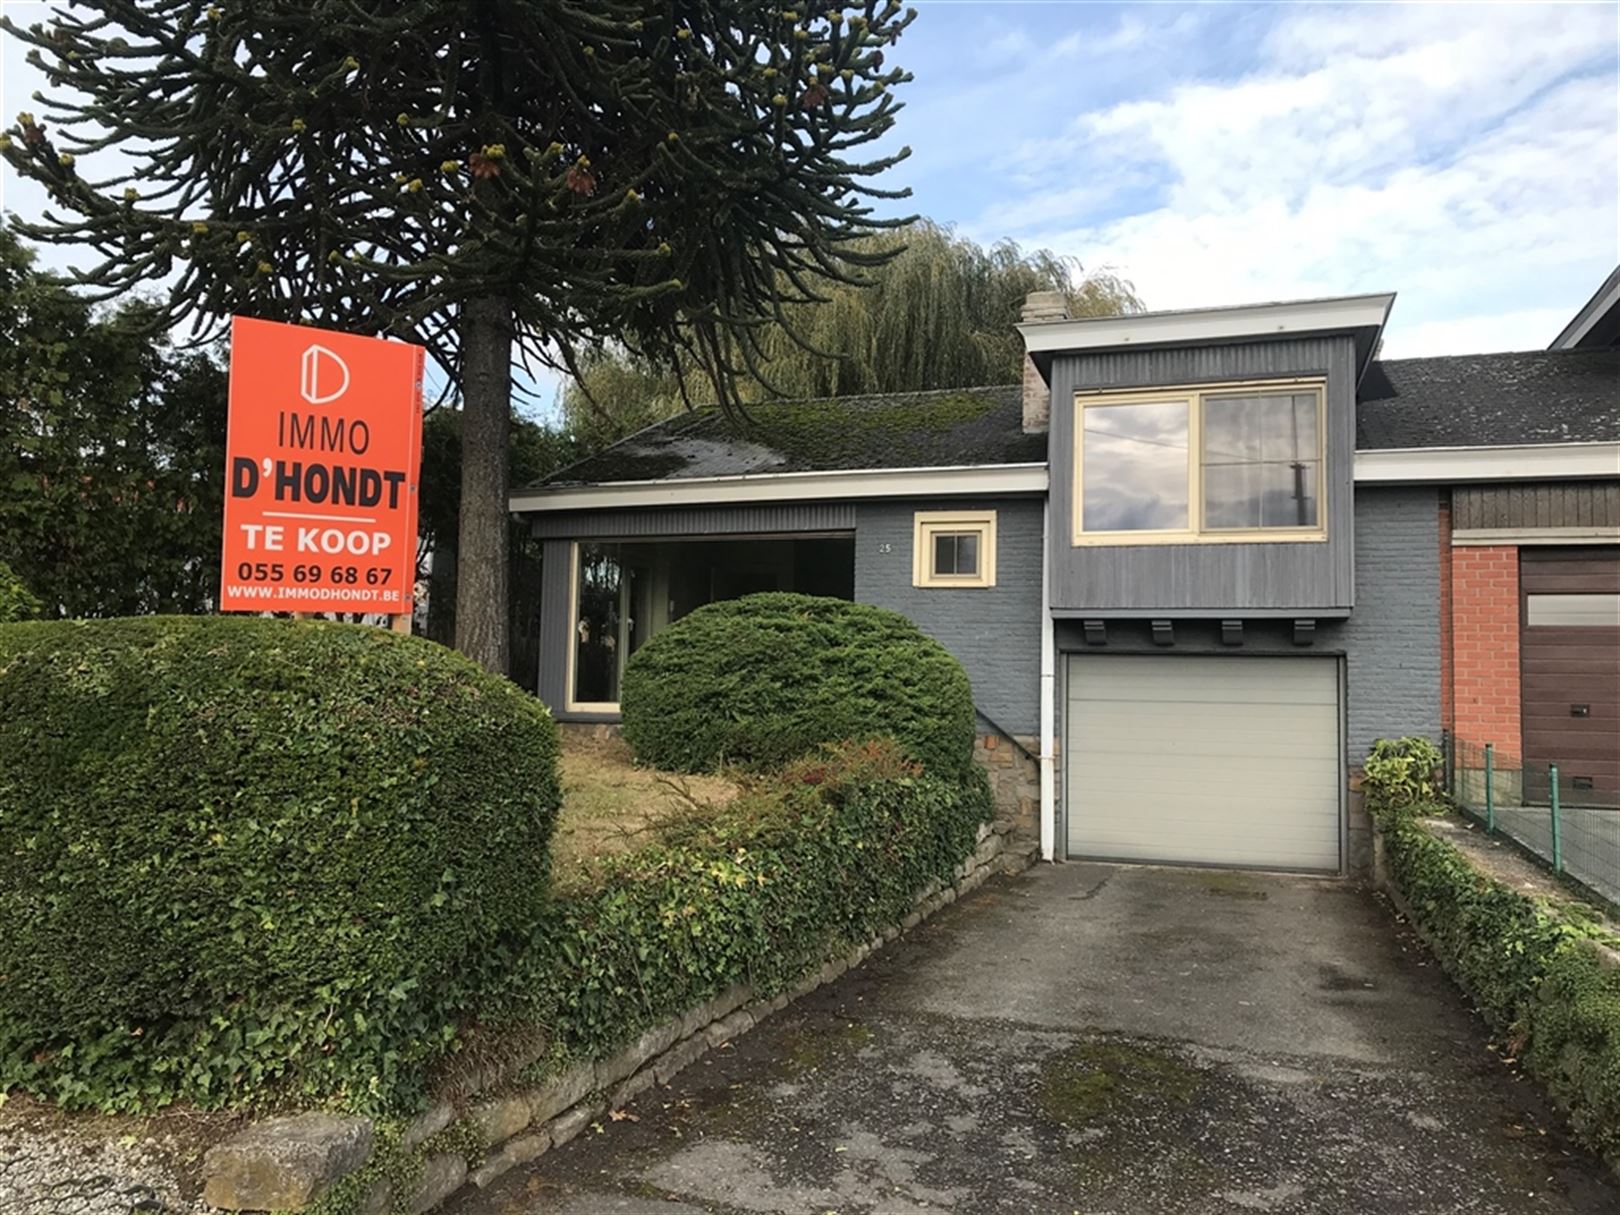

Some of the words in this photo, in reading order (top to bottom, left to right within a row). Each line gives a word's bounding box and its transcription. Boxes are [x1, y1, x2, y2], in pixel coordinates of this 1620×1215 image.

[279, 411, 370, 455] IMMO
[232, 456, 406, 510] D'HONDT
[240, 524, 284, 551] TE
[297, 527, 391, 555] KOOP
[238, 562, 284, 582] 055
[293, 564, 322, 583] 69
[330, 566, 358, 585] 68
[366, 567, 393, 585] 67
[227, 585, 400, 602] WWW.IMMODHONDT.BE
